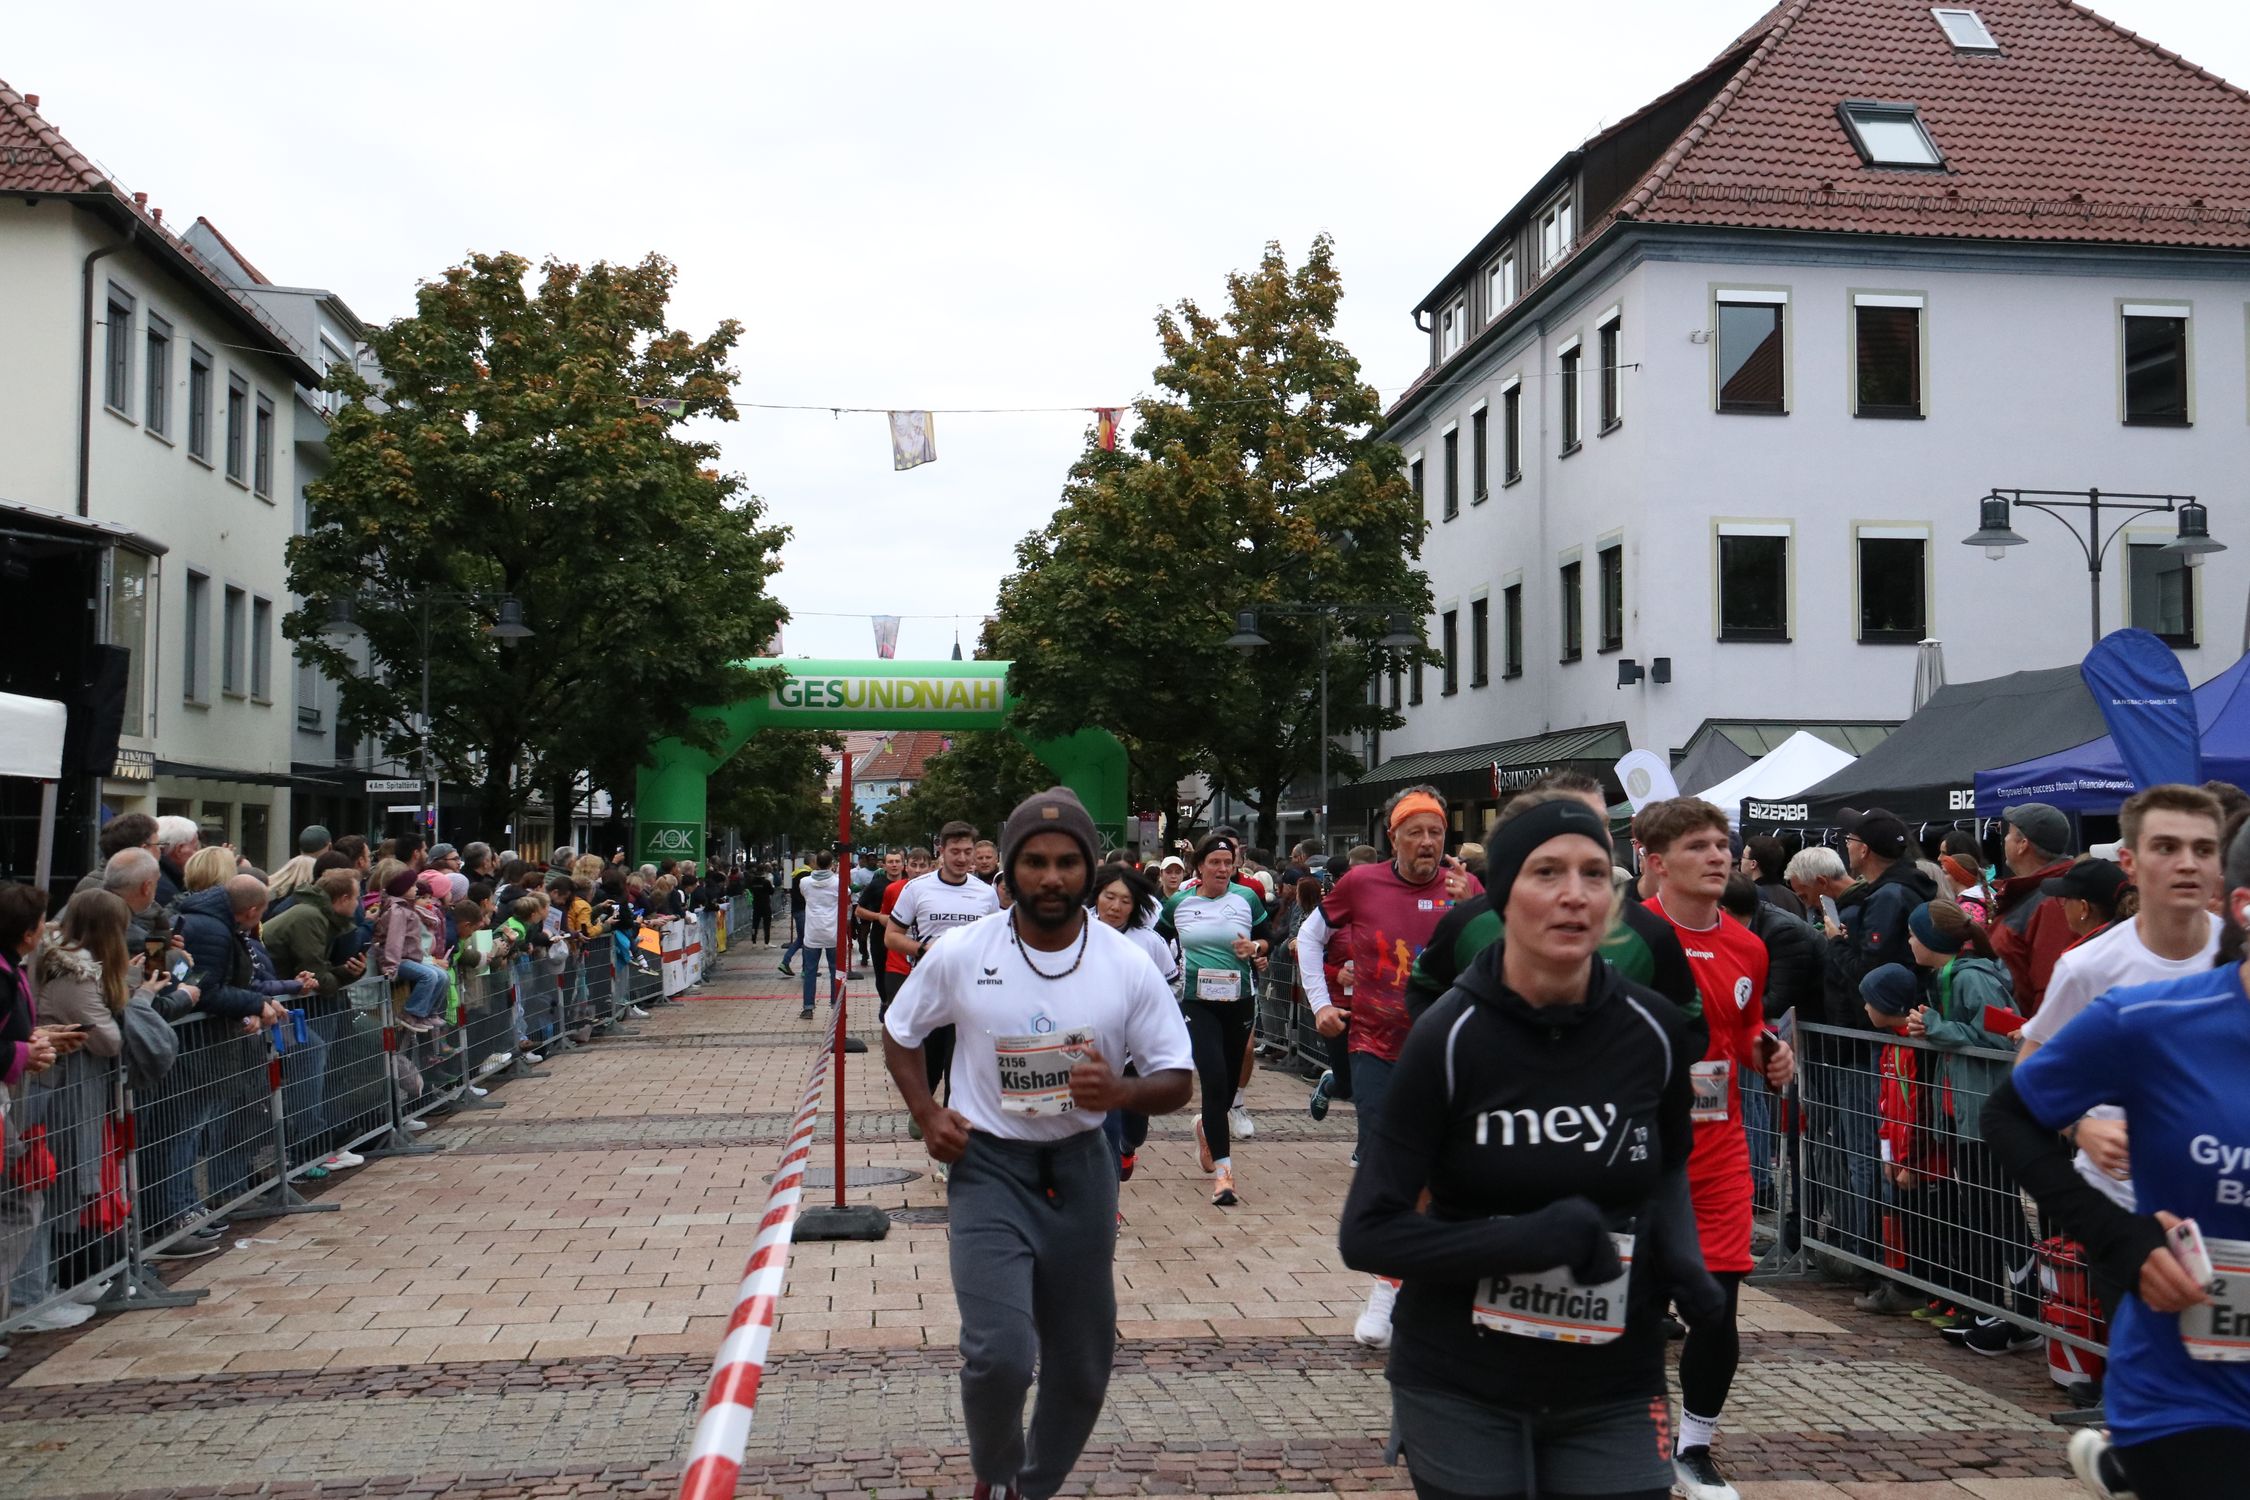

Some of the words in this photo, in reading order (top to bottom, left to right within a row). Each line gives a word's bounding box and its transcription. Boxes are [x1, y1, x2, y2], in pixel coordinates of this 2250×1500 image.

[777, 679, 997, 709] GESUNDNAH
[1997, 786, 2032, 797] Empowering
[2033, 783, 2055, 794] success
[2056, 780, 2078, 792] through
[2079, 780, 2106, 789] financial
[1950, 789, 1975, 809] BIZ
[1749, 802, 1808, 820] BIZERBA
[648, 829, 694, 848] AOK
[1685, 948, 1714, 960] Kempa
[998, 1057, 1026, 1068] 2156
[1000, 1069, 1071, 1090] Kishan
[1060, 1101, 1074, 1112] 21
[1488, 1274, 1610, 1321] Patricia
